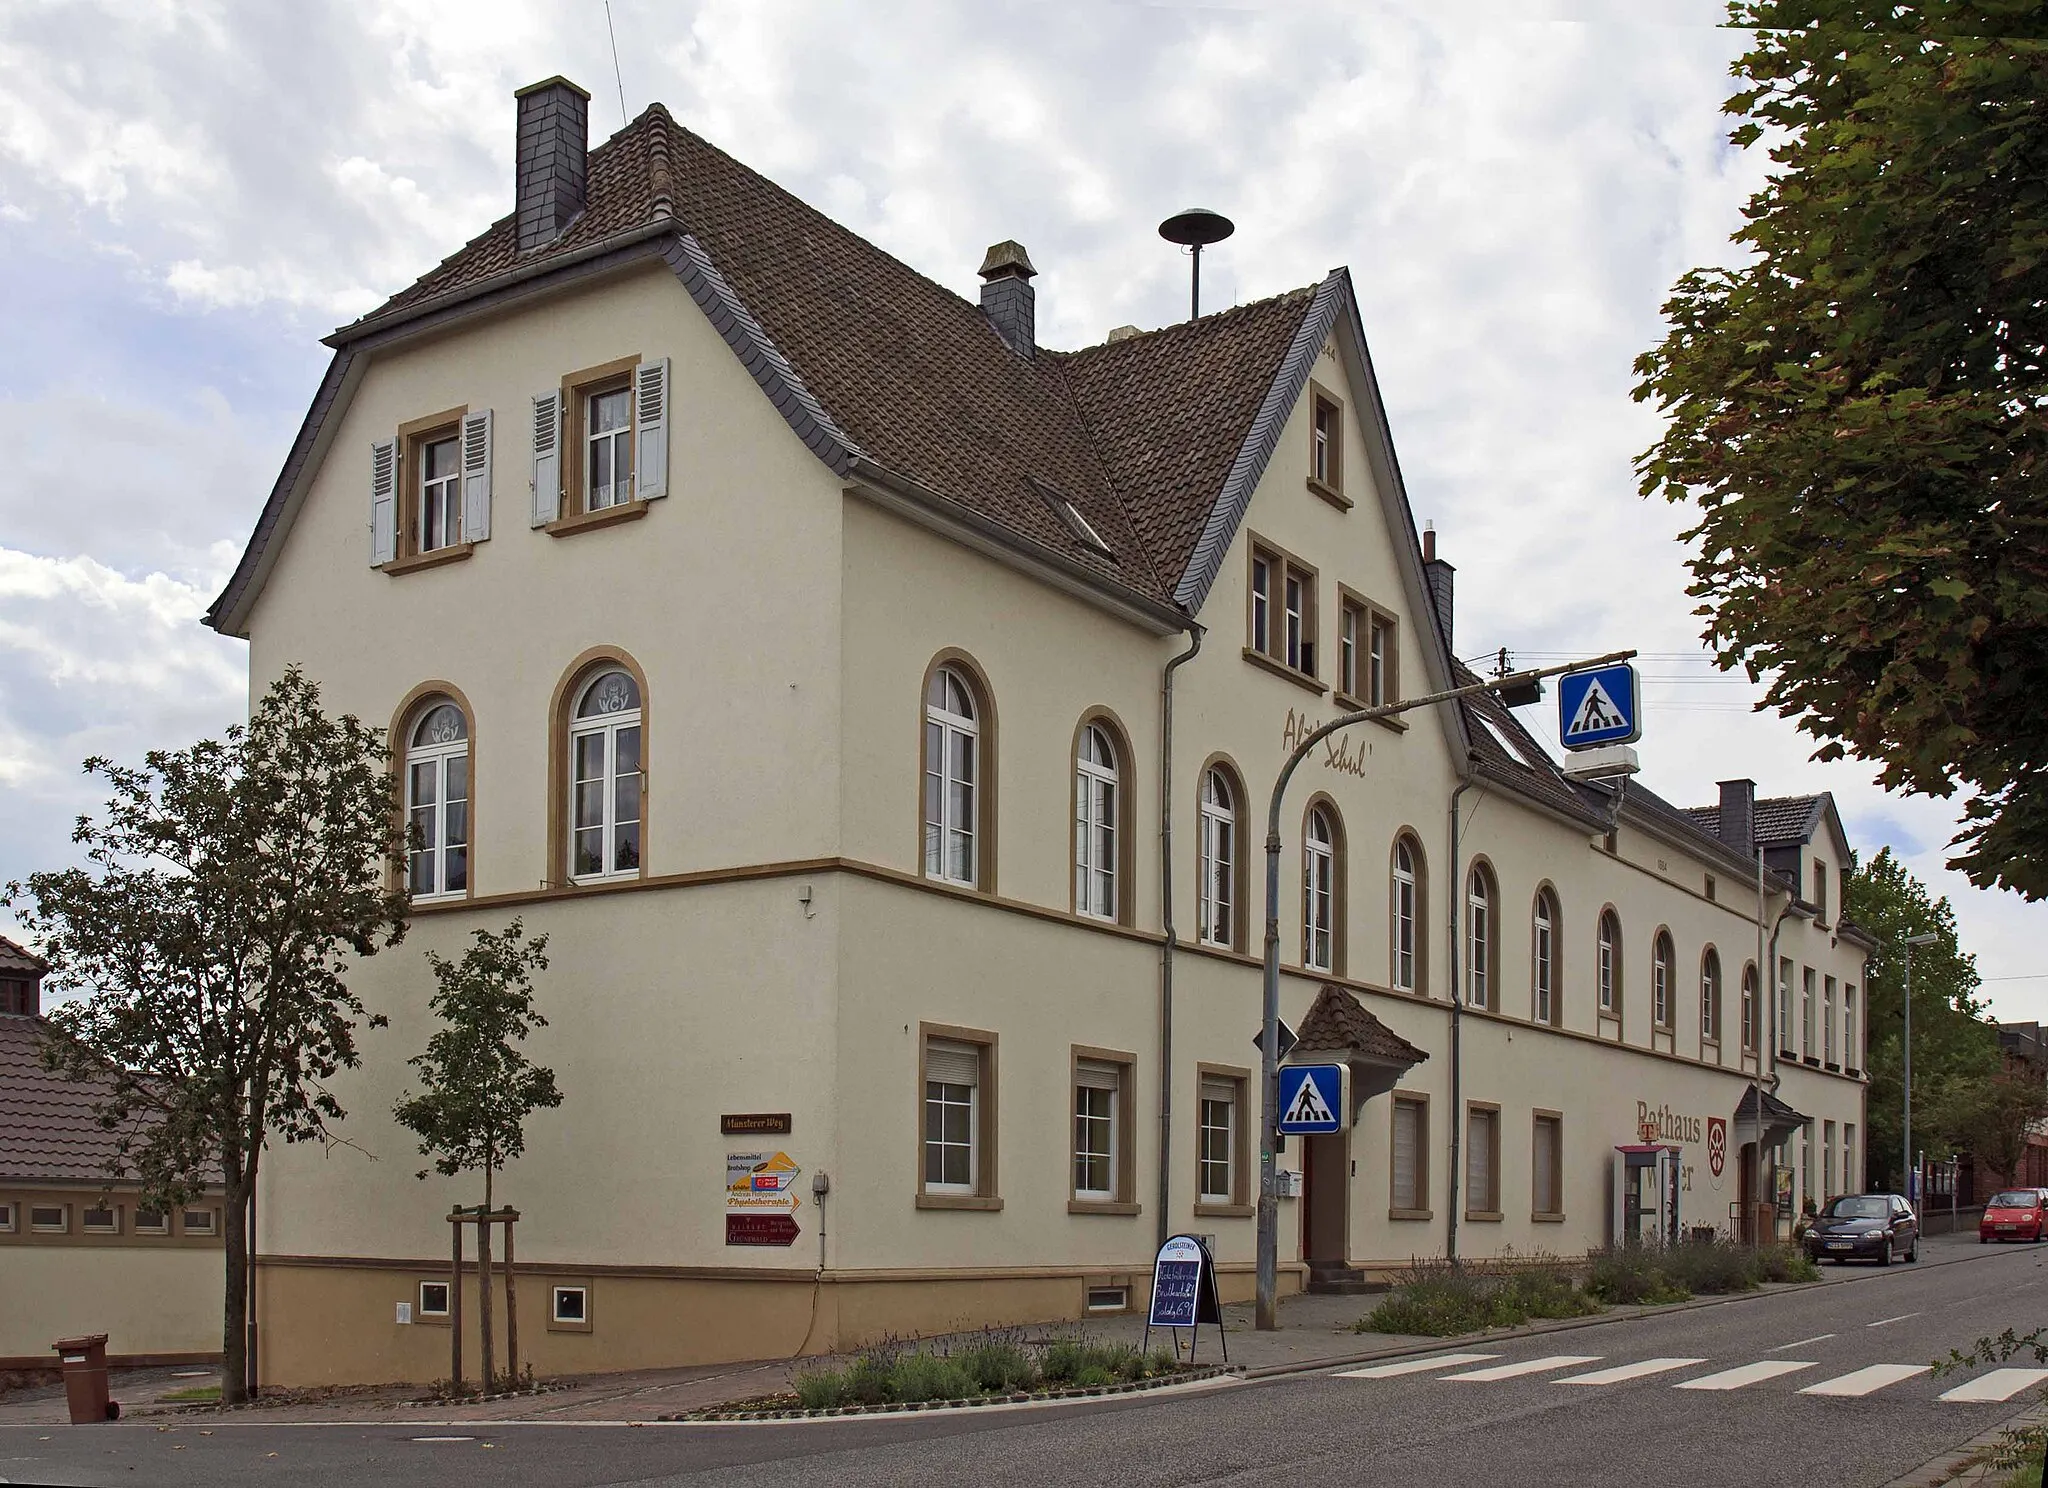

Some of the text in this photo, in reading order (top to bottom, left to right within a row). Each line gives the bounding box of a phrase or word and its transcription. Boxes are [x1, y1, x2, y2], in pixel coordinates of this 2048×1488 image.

[766, 1117, 784, 1130] Weg
[727, 1197, 789, 1208] Physiotherapie
[1166, 1242, 1196, 1251] GEROLSTEINER
